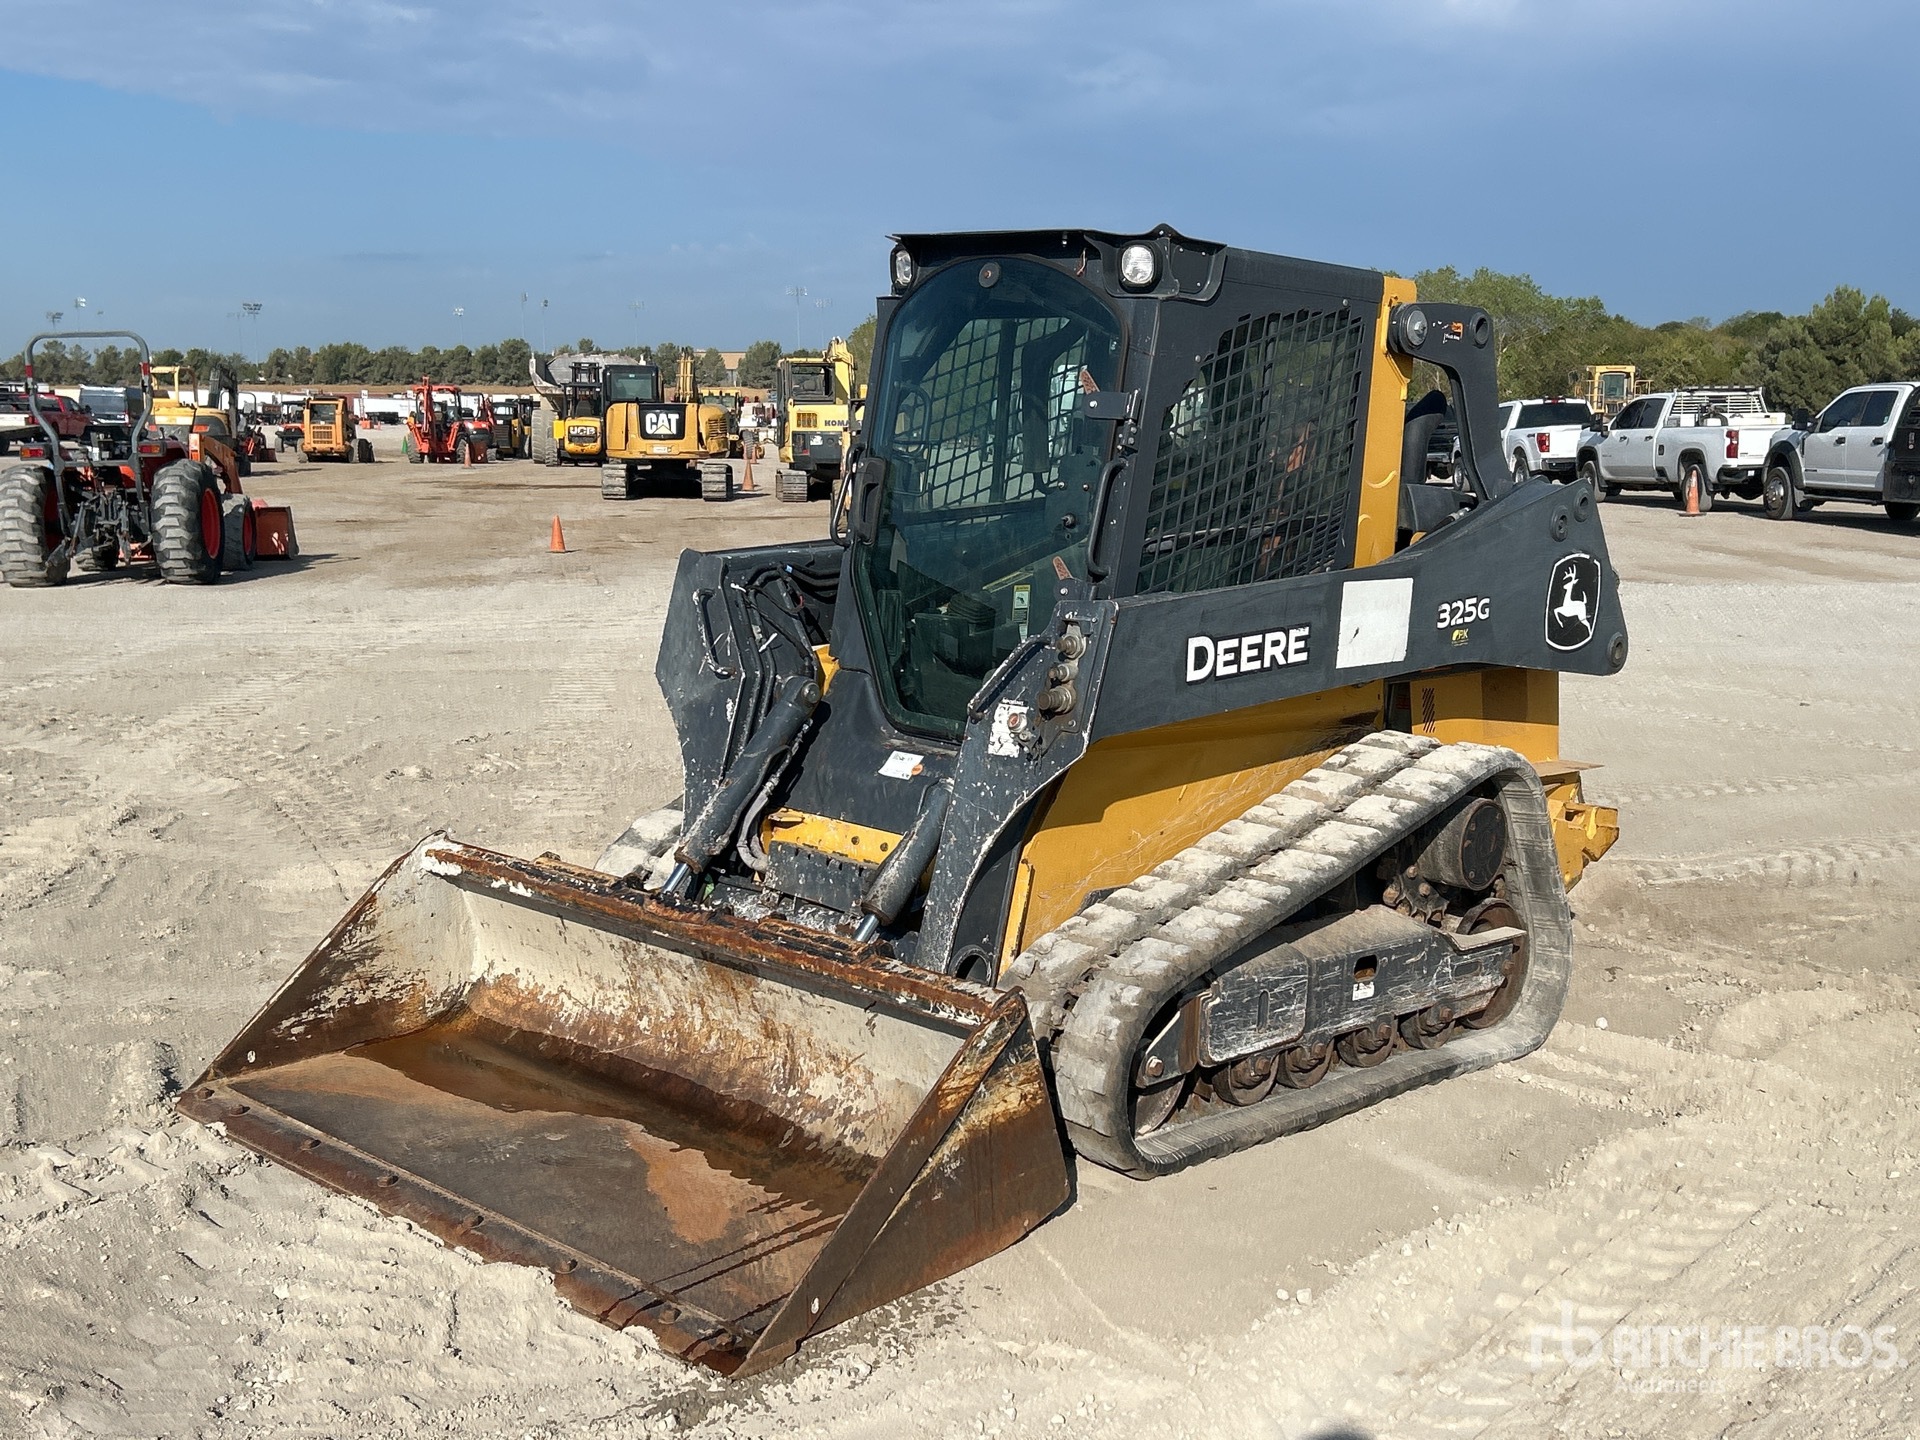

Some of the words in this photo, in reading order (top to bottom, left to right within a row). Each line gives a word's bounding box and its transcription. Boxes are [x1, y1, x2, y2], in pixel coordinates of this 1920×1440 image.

[569, 426, 596, 436] JCB
[645, 413, 680, 435] CAT
[824, 419, 851, 427] KOMA
[1436, 596, 1491, 629] 325G
[1186, 626, 1310, 682] DEERE
